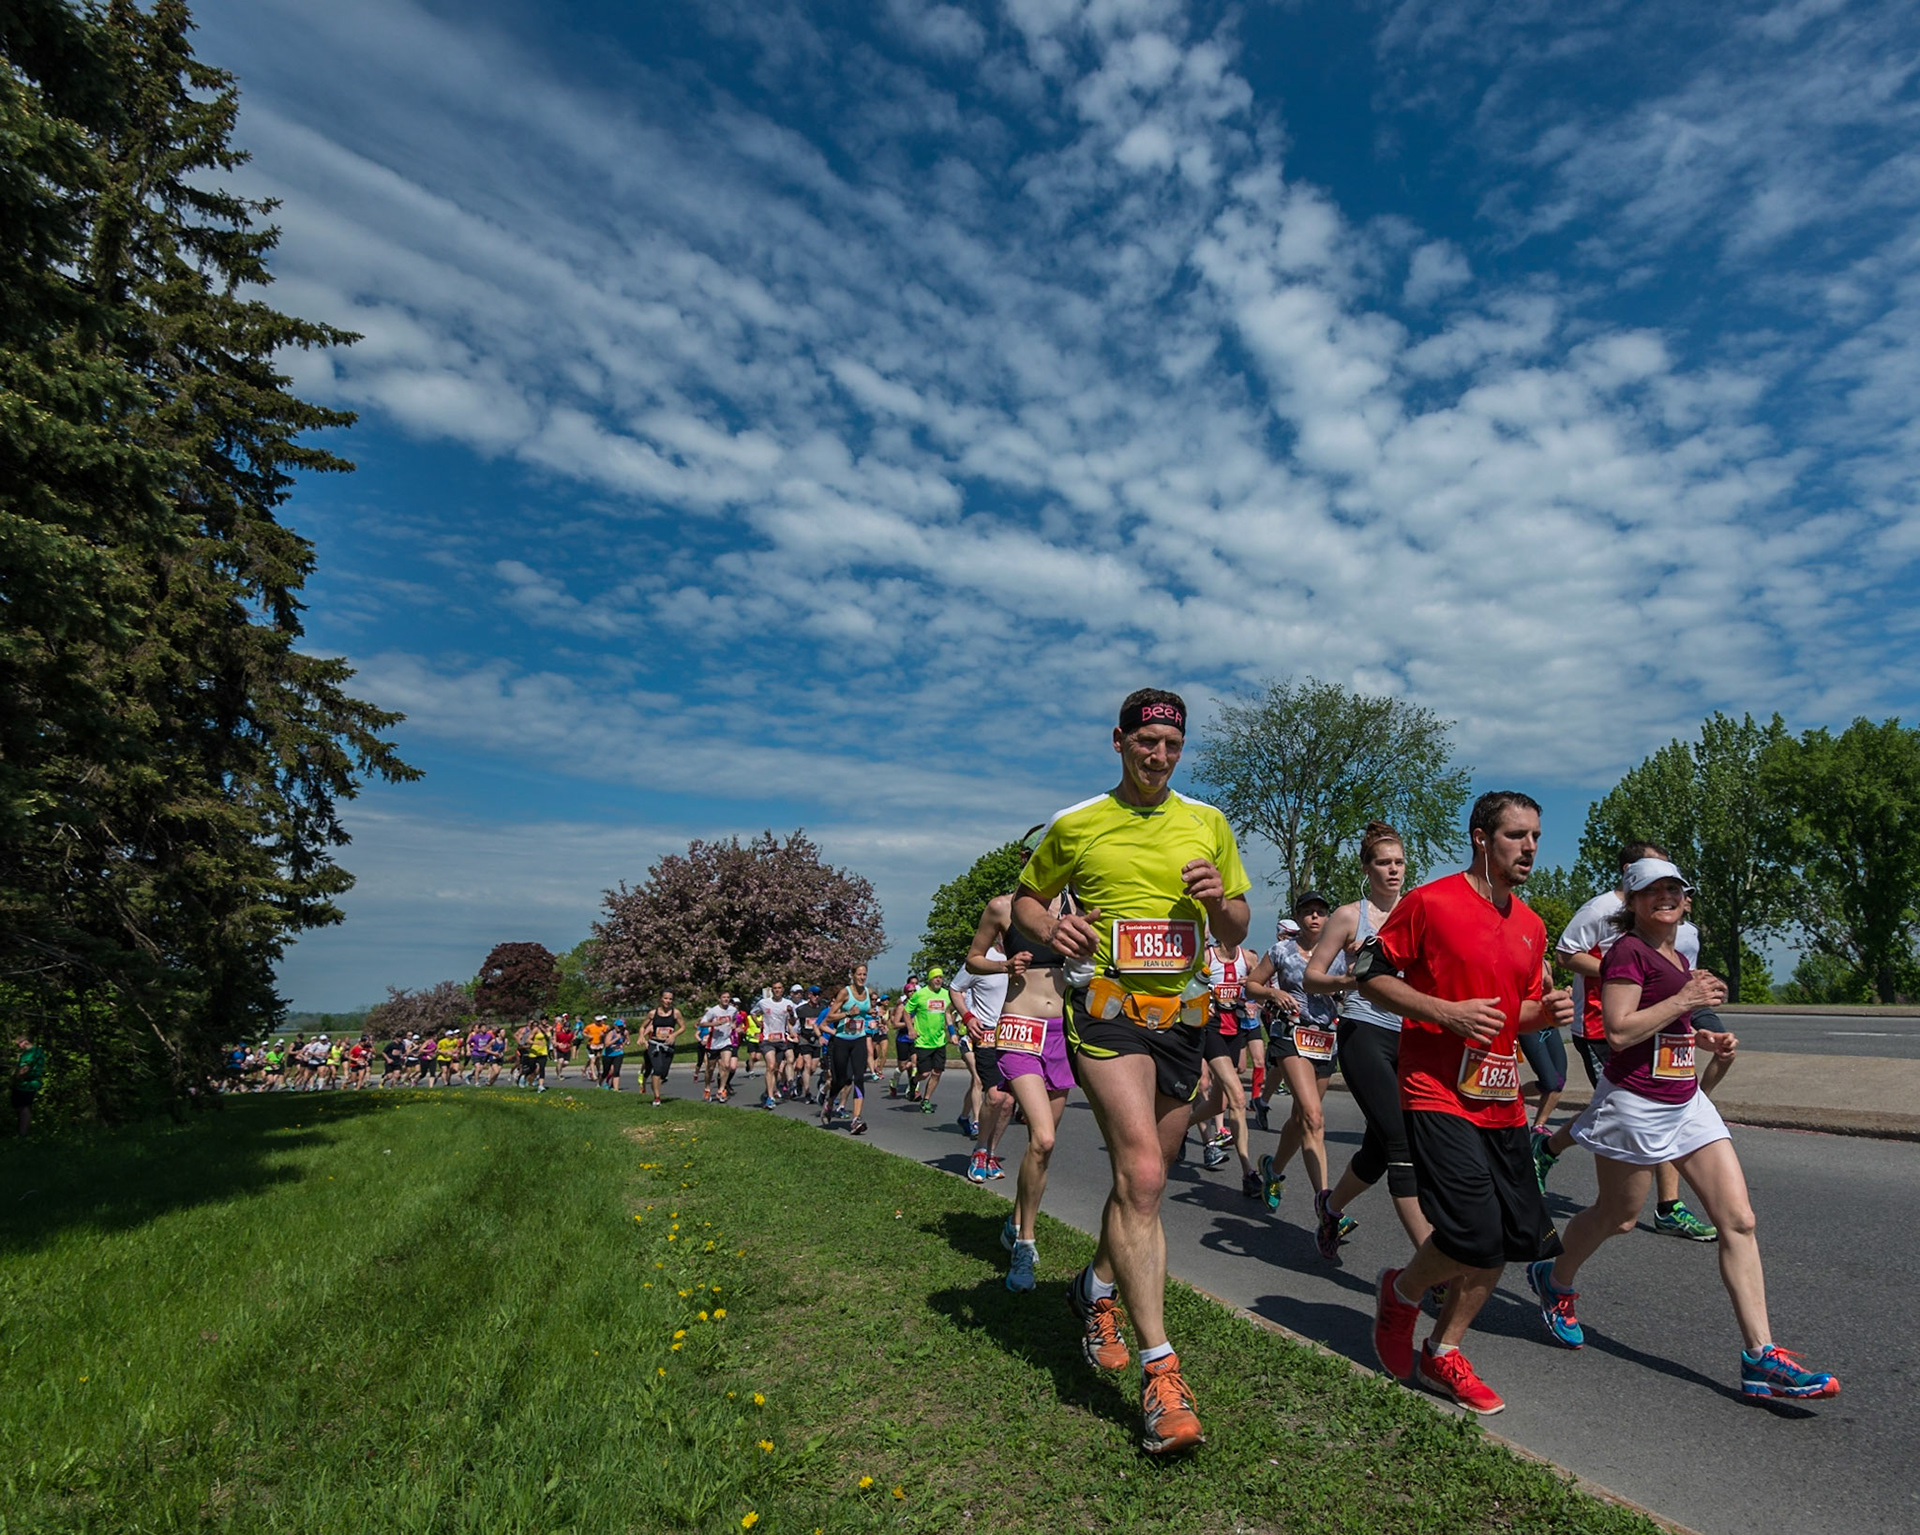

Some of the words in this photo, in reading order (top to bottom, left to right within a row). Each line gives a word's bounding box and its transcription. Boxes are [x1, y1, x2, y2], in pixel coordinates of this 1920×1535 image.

[1134, 932, 1183, 957] 18518
[999, 1023, 1033, 1043] 20781
[1301, 1033, 1326, 1047] 14758
